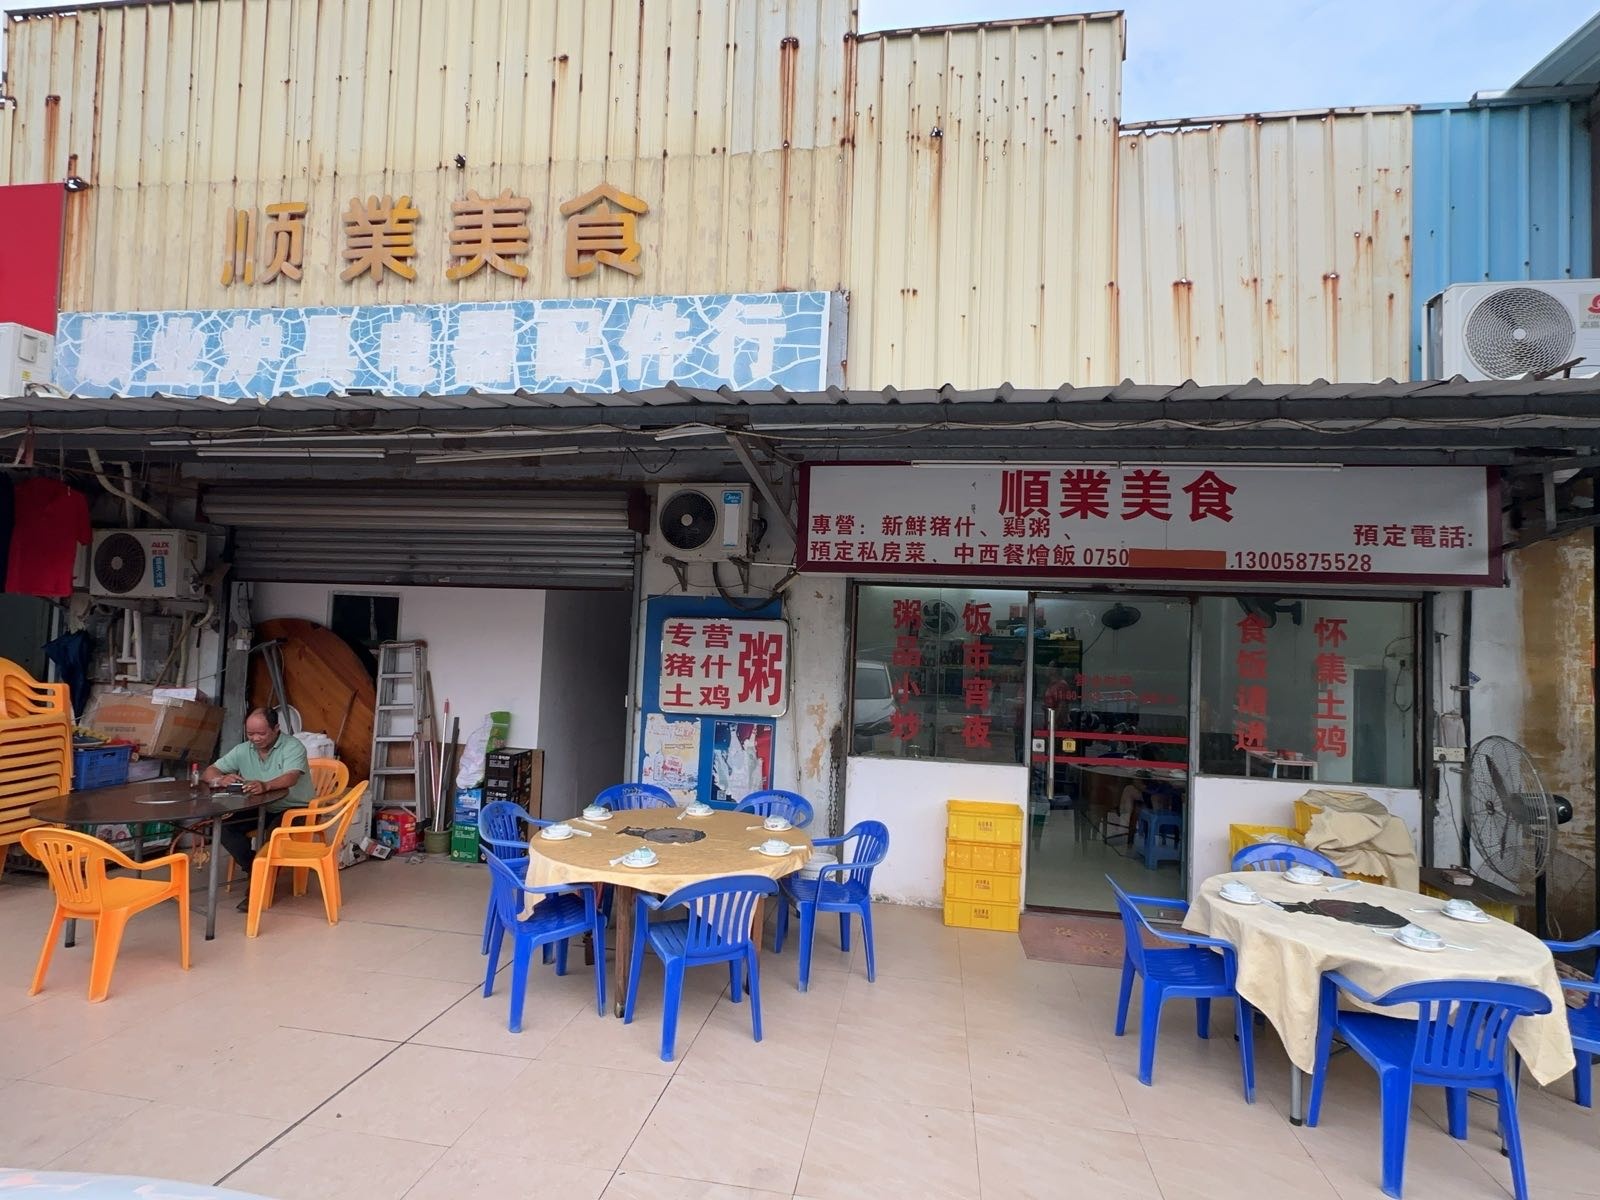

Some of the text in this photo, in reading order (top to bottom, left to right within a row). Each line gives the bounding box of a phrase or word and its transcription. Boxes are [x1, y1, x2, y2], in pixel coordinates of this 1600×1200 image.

[221, 182, 649, 287] 顺業美食
[999, 469, 1237, 522] 順業美食
[664, 653, 732, 679] 猪什
[665, 622, 733, 649] 专营
[738, 631, 783, 706] 粥
[889, 599, 922, 741] 粥品小炒
[664, 684, 731, 709] 土鸡
[961, 602, 993, 748] 饭市宵夜
[1313, 617, 1348, 758] 怀集土鸡
